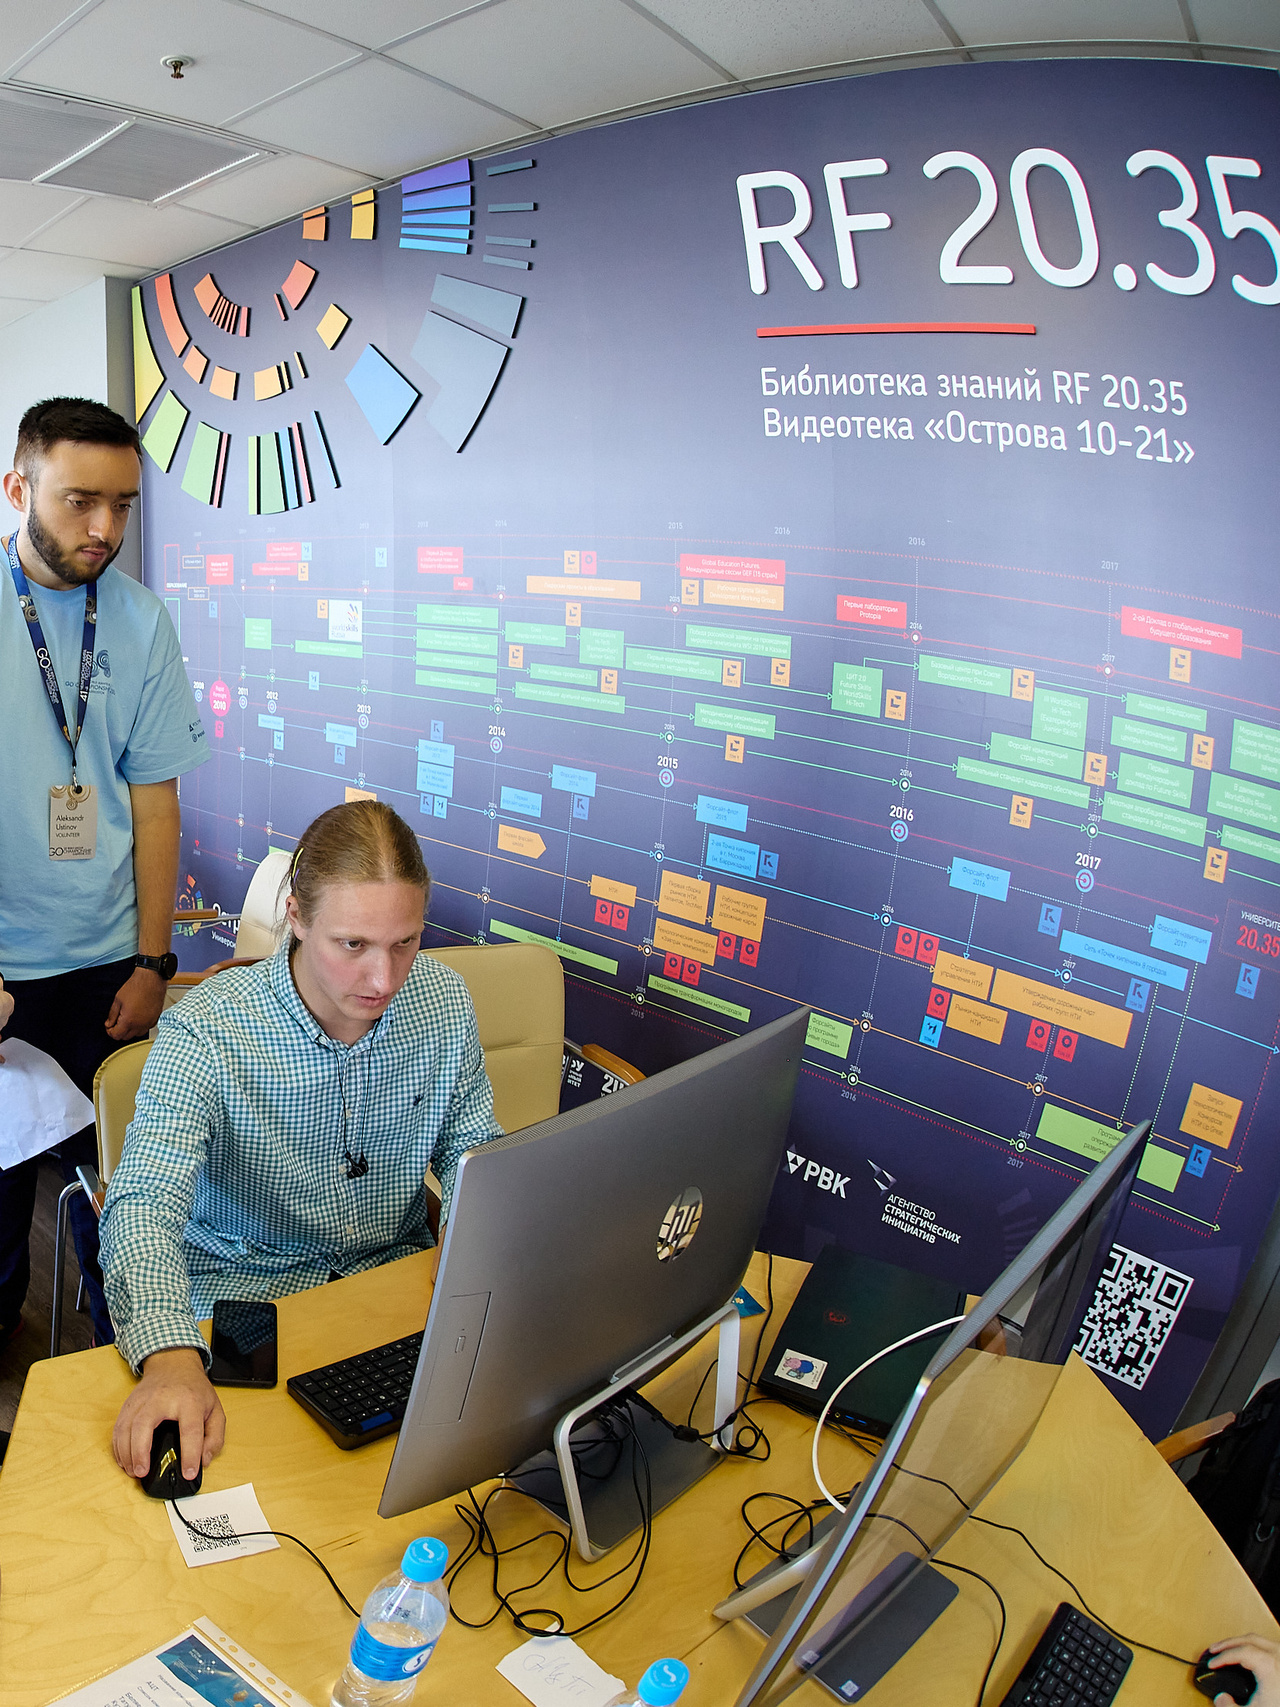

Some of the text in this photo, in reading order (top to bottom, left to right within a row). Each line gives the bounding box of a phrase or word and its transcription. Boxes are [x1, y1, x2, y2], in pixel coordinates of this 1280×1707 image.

[736, 148, 1280, 305] RF 20.35
[761, 364, 1188, 415] Библиотека знаний RF 20.35
[763, 407, 1195, 465] Видеотека «Острова 10-21»
[668, 521, 683, 530] 2015
[774, 527, 790, 535] 2016
[908, 536, 926, 546] 2016
[718, 560, 739, 568] Education
[1101, 561, 1118, 571] 2017
[844, 600, 898, 613] Первые лаборатории
[860, 611, 881, 620] Protopia
[910, 622, 922, 630] 2016
[1146, 615, 1166, 627] Доклад
[1173, 621, 1203, 634] глобальной
[1205, 628, 1229, 640] повестке
[1149, 627, 1176, 639] будущего
[37, 648, 51, 668] GO
[1101, 654, 1115, 662] 2017
[840, 681, 857, 690] Future
[266, 691, 278, 700] 2012
[843, 689, 872, 700] WorldSkills
[213, 700, 226, 710] 2010
[846, 700, 865, 708] Hi-Tech
[356, 704, 372, 714] 2013
[488, 726, 506, 737] 2014
[657, 755, 679, 769] 2015
[900, 769, 913, 778] 2016
[1173, 790, 1187, 799] Skills
[716, 813, 727, 821] 2015
[889, 805, 914, 821] 2016
[1087, 814, 1101, 822] 2017
[654, 842, 665, 850] 2015
[49, 847, 64, 856] GO
[1075, 853, 1101, 870] 2017
[973, 879, 986, 887] 2016
[882, 904, 894, 913] 2016
[643, 937, 653, 945] 2015
[1174, 939, 1187, 948] 2017
[1236, 925, 1280, 958] 20.35
[1062, 960, 1076, 969] 2017
[972, 979, 983, 988] НТИ
[631, 1009, 645, 1019] 2015
[862, 1011, 874, 1020] 2016
[1069, 1012, 1081, 1021] НТИ
[970, 1018, 982, 1026] НТИ
[849, 1064, 861, 1073] 2016
[1035, 1074, 1047, 1082] 2017
[841, 1090, 857, 1102] 2016
[1018, 1130, 1031, 1139] 2017
[1007, 1157, 1023, 1168] 2017
[803, 1160, 851, 1199] РВК
[888, 1194, 936, 1220] АГЕНТСТВО
[881, 1213, 936, 1244] ИНИЦИАТИВ
[884, 1204, 961, 1244] СТРАТЕГИЧЕСКИХ
